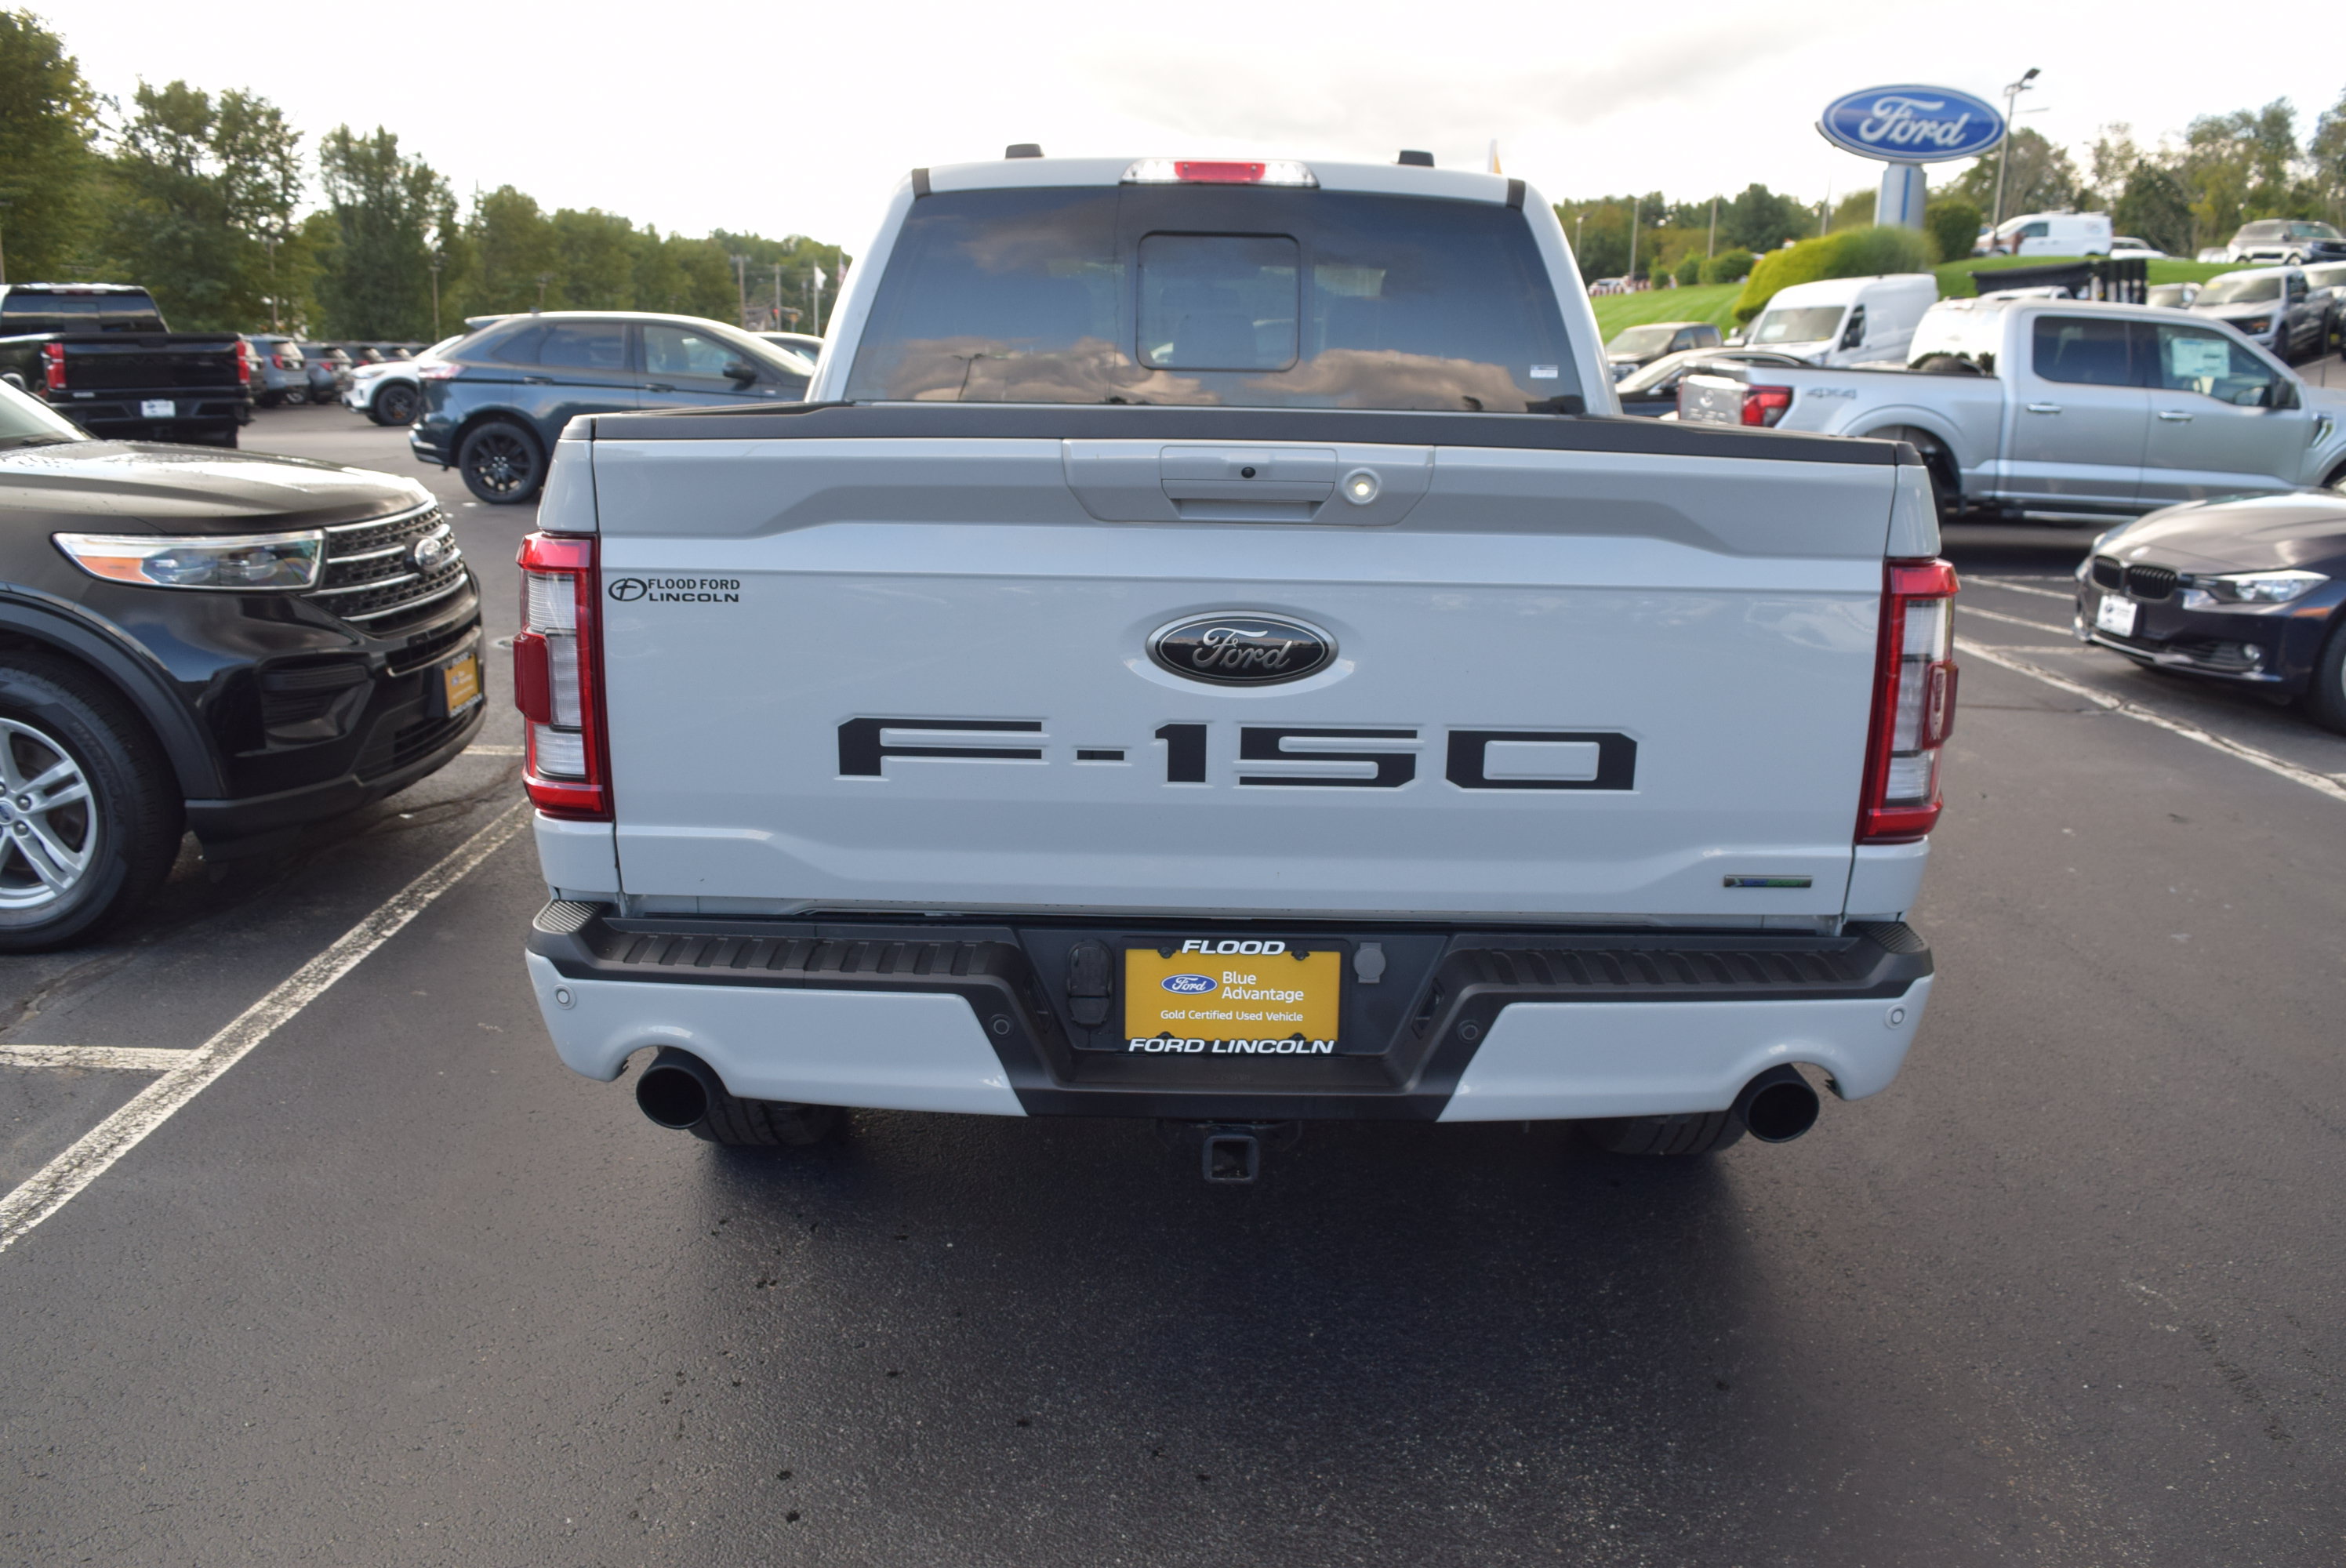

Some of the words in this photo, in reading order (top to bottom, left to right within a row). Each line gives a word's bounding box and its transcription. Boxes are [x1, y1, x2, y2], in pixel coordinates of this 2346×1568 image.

[1858, 95, 1972, 147] Ford
[648, 579, 696, 589] FLOOD
[699, 579, 740, 590] FORD
[648, 593, 739, 602] LINCOLN
[1192, 626, 1293, 669] Ford
[837, 717, 1638, 791] F-150
[1181, 939, 1286, 955] FLOOD
[1171, 976, 1208, 991] Ford
[1222, 971, 1257, 985] Blue
[1222, 986, 1305, 1004] Advantage
[1160, 1010, 1186, 1020] Gold
[1188, 1010, 1233, 1021] Certified
[1236, 1011, 1262, 1021] Used
[1266, 1011, 1304, 1022] Vehicle
[1128, 1038, 1205, 1052] FORD
[1211, 1039, 1335, 1054] LINCOLN
